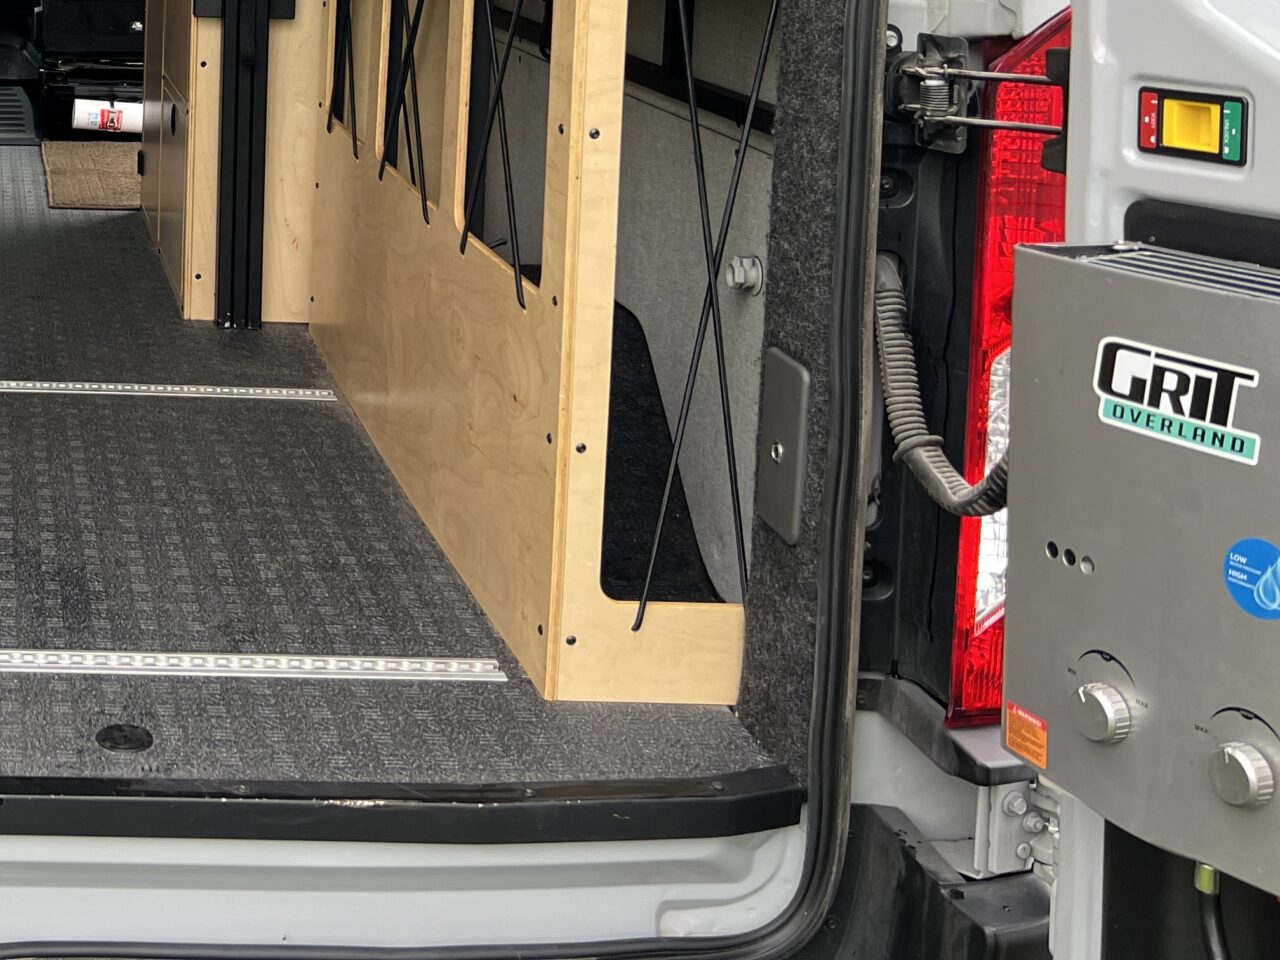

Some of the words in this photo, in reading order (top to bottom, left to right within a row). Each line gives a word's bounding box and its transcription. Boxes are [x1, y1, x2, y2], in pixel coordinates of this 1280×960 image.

[1097, 341, 1255, 428] GRIT
[1112, 403, 1245, 454] OVERLAND
[1230, 552, 1247, 564] LOW
[1229, 568, 1247, 580] HIGH
